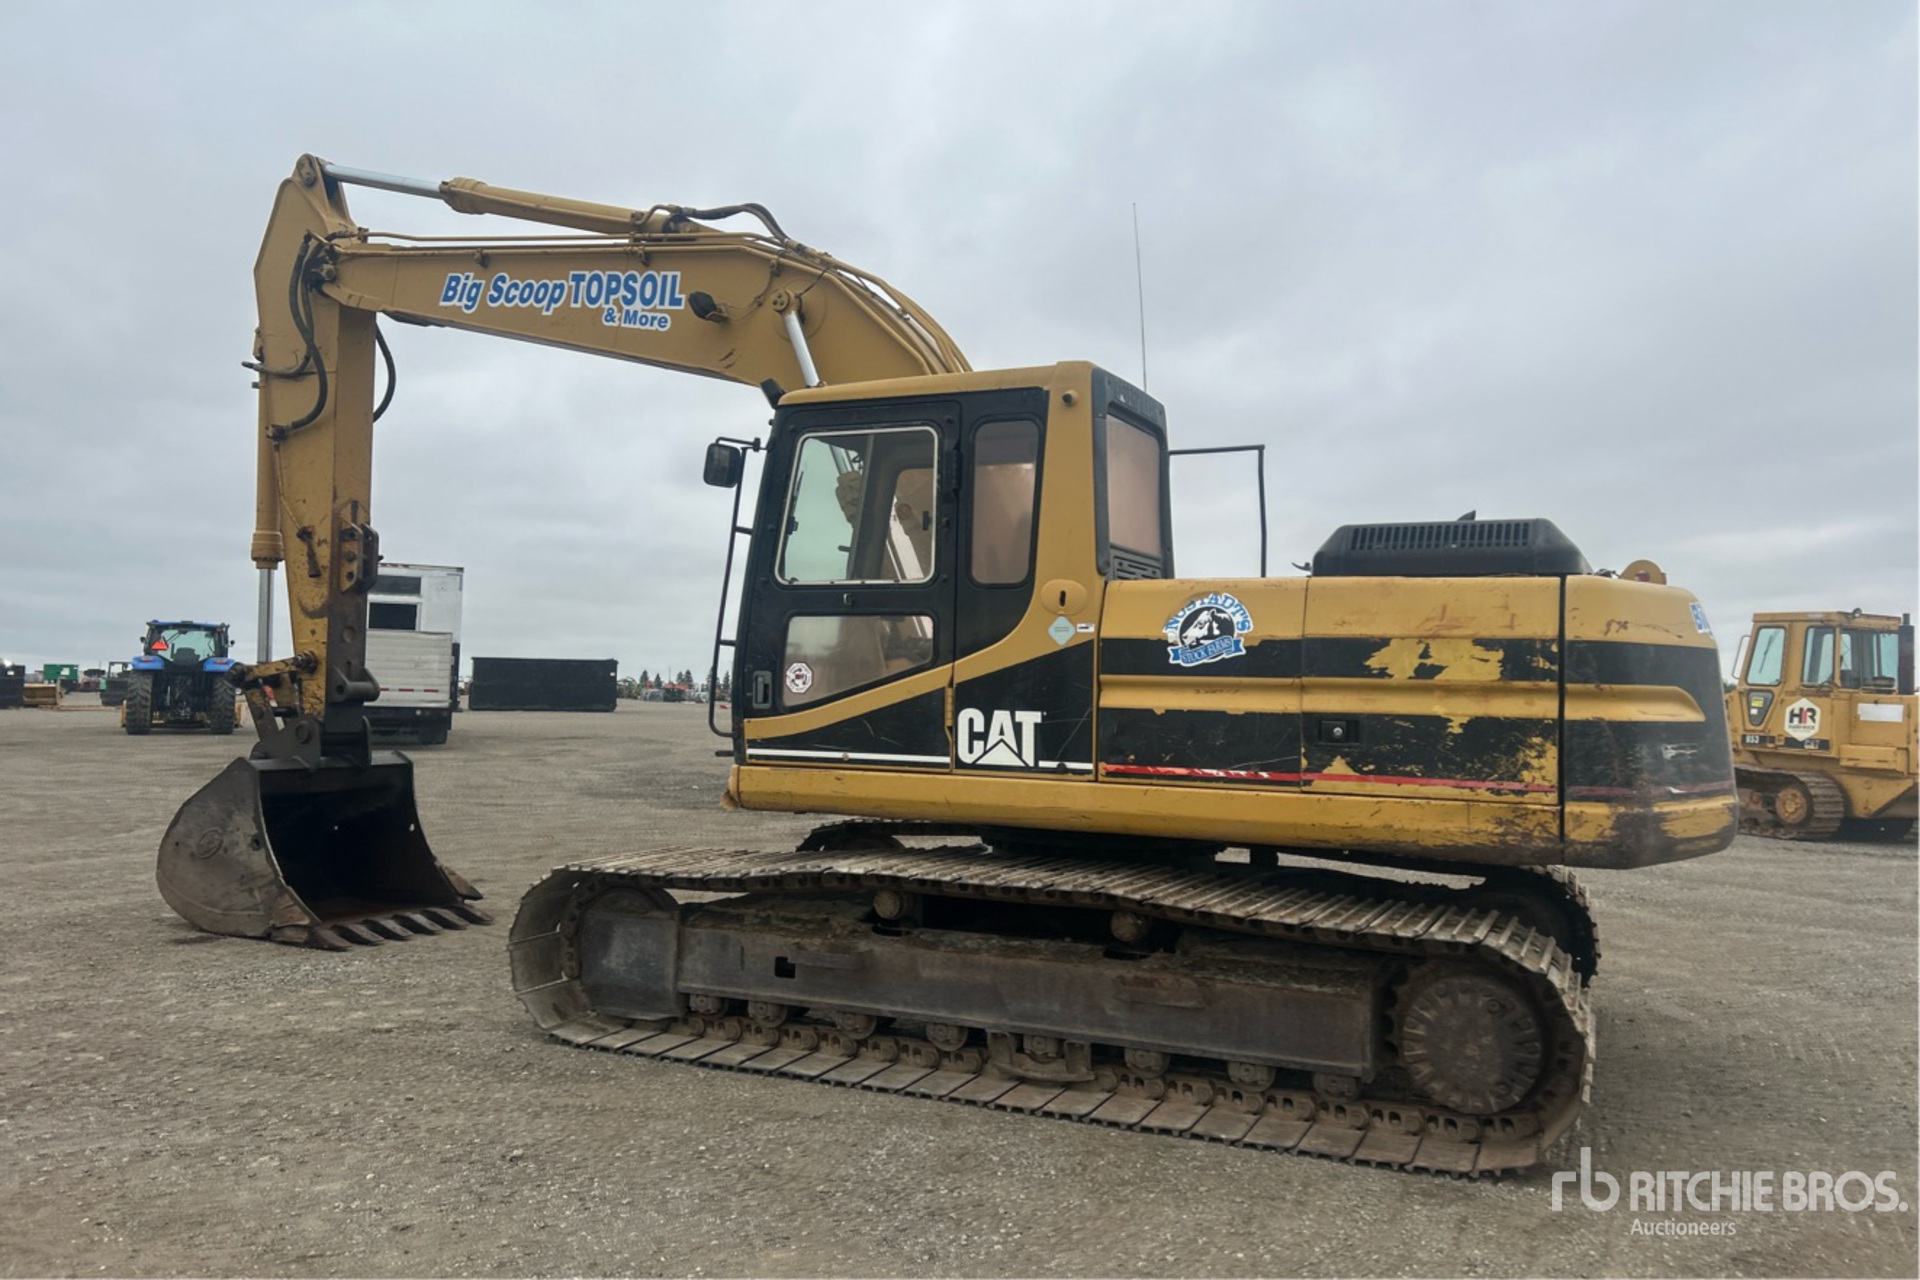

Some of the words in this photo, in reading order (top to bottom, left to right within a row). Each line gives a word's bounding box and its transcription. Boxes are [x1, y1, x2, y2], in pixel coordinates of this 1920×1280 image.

[441, 274, 484, 311] Big
[487, 273, 566, 313] Scoop
[570, 272, 684, 308] TOPSOIL
[603, 307, 617, 324] &
[623, 310, 669, 329] More
[957, 708, 1042, 767] CAT
